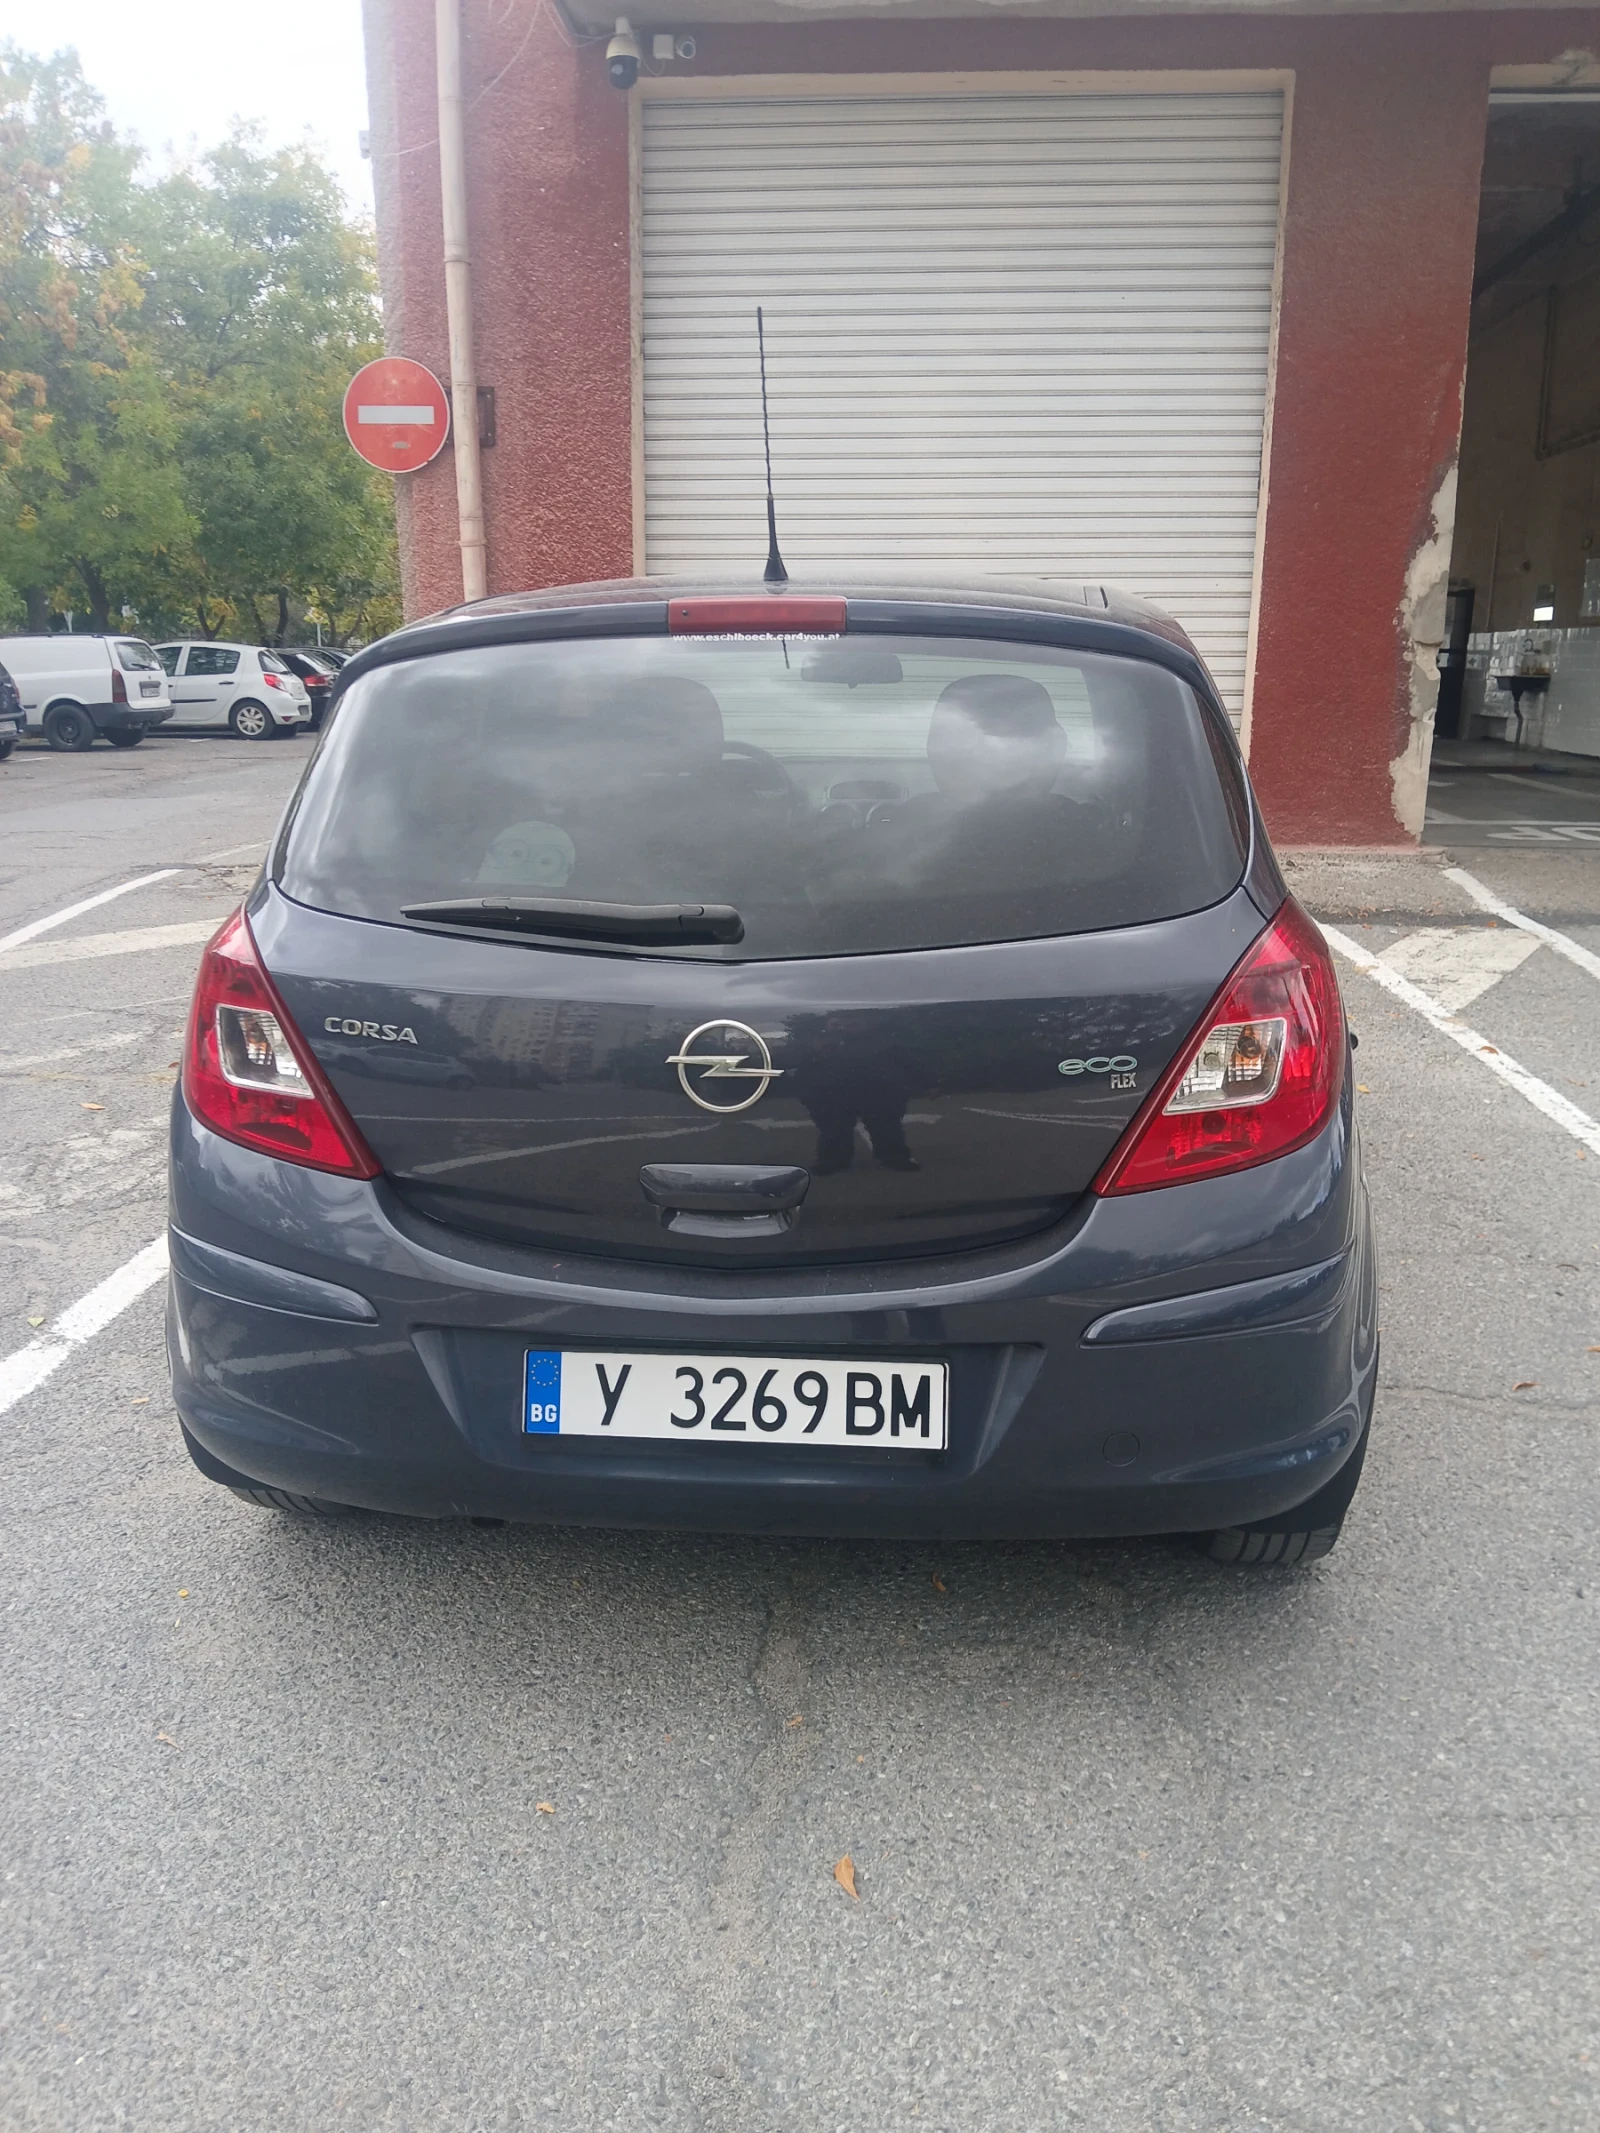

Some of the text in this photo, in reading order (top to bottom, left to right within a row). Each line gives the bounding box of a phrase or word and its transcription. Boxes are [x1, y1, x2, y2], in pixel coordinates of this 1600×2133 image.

[324, 1017, 418, 1045] CORSA
[1058, 1055, 1138, 1075] eco
[1111, 1072, 1137, 1089] FLEX
[530, 1403, 557, 1423] BG
